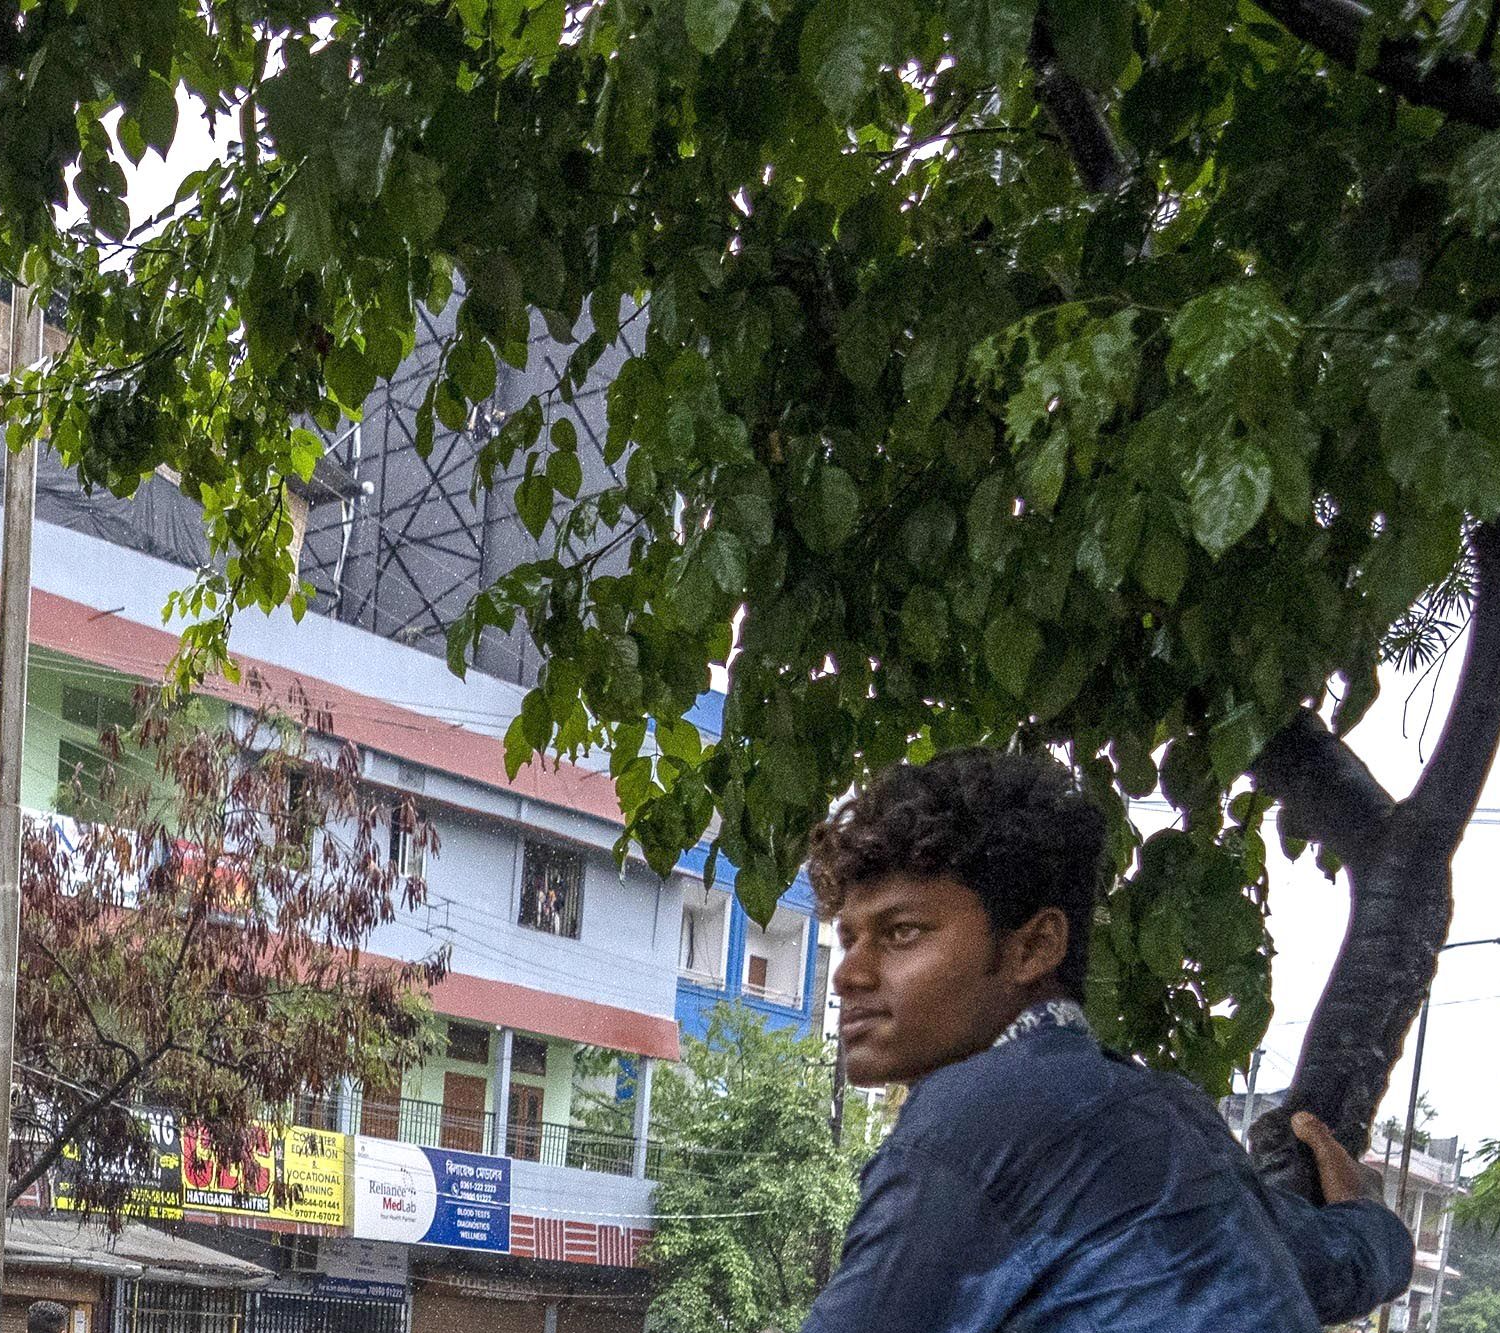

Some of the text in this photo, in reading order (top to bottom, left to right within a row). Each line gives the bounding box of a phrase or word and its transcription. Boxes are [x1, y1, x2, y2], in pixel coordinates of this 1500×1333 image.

[286, 1168, 341, 1185] VOCATIONAL
[369, 1180, 406, 1197] Reliance
[187, 1190, 233, 1208] HATIGAON
[382, 1197, 416, 1214] MedLab
